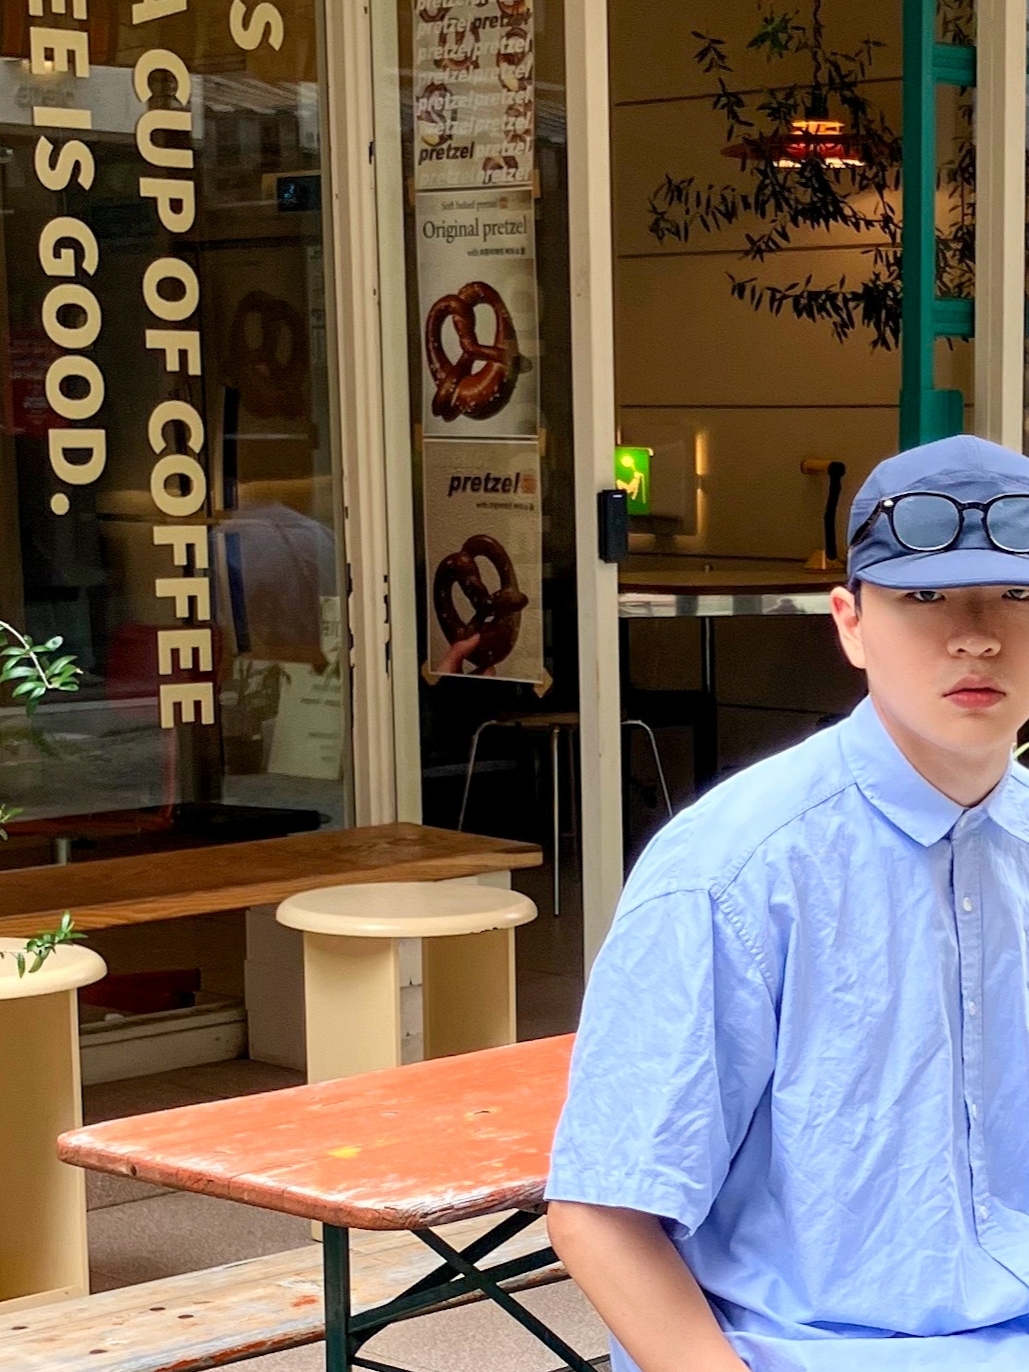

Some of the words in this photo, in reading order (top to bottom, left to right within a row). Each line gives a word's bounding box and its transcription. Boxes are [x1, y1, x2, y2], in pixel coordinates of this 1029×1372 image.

[33, 106, 95, 191] IS
[134, 49, 195, 233] CUP
[418, 142, 475, 165] pretzel
[422, 217, 479, 243] Original
[483, 214, 528, 243] pretzel
[39, 216, 107, 516] GOOD.
[143, 257, 202, 376] OF
[447, 472, 521, 497] pretzel
[148, 400, 214, 729] COFFEE
